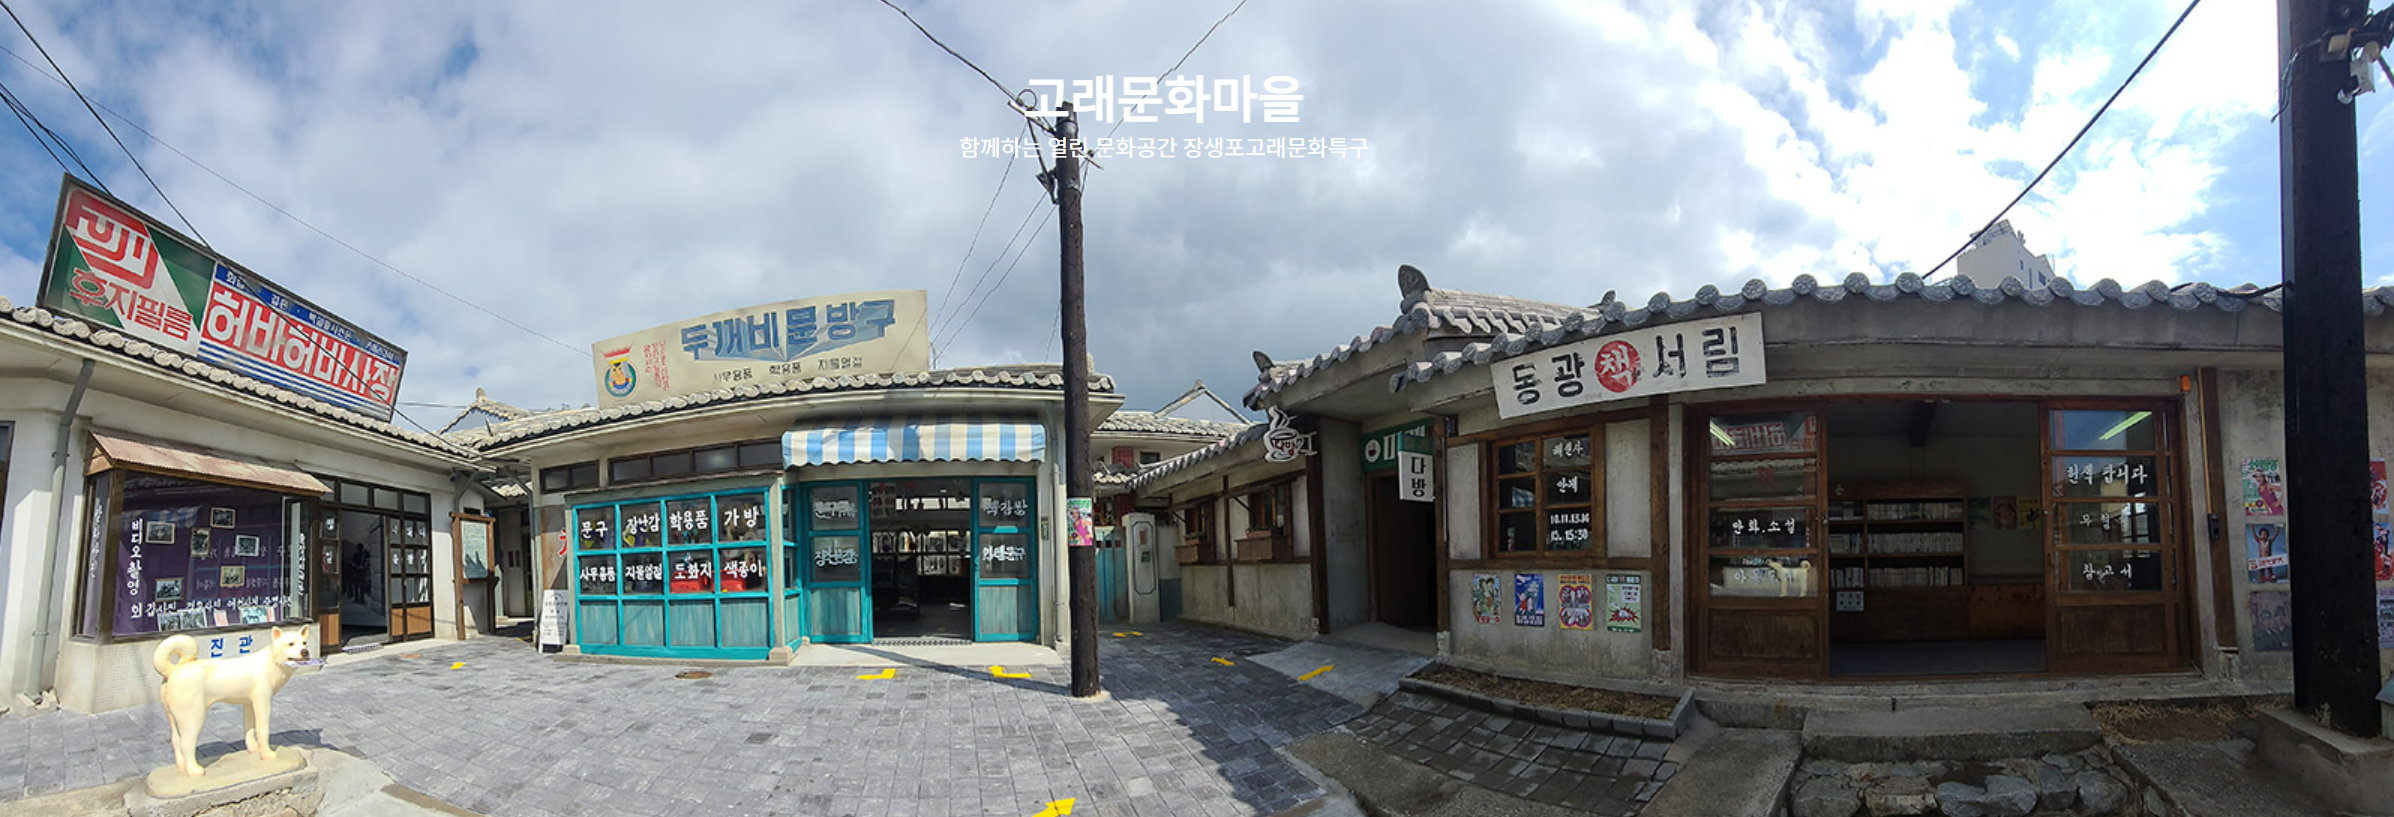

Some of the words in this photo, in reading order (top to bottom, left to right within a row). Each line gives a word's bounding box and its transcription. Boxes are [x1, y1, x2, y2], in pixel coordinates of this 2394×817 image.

[69, 267, 193, 341] 후지필름
[206, 291, 397, 400] 허바허바사장
[769, 361, 802, 375] 학용품
[1411, 456, 1427, 497] 다방
[581, 521, 608, 539] 문구
[626, 513, 660, 535] 장난감
[669, 510, 709, 531] 학용품
[724, 505, 760, 528] 가방
[127, 518, 144, 596] 비디오촬영
[579, 566, 617, 582] 사무용품
[674, 561, 712, 580] 도화지
[723, 559, 763, 579] 색종이
